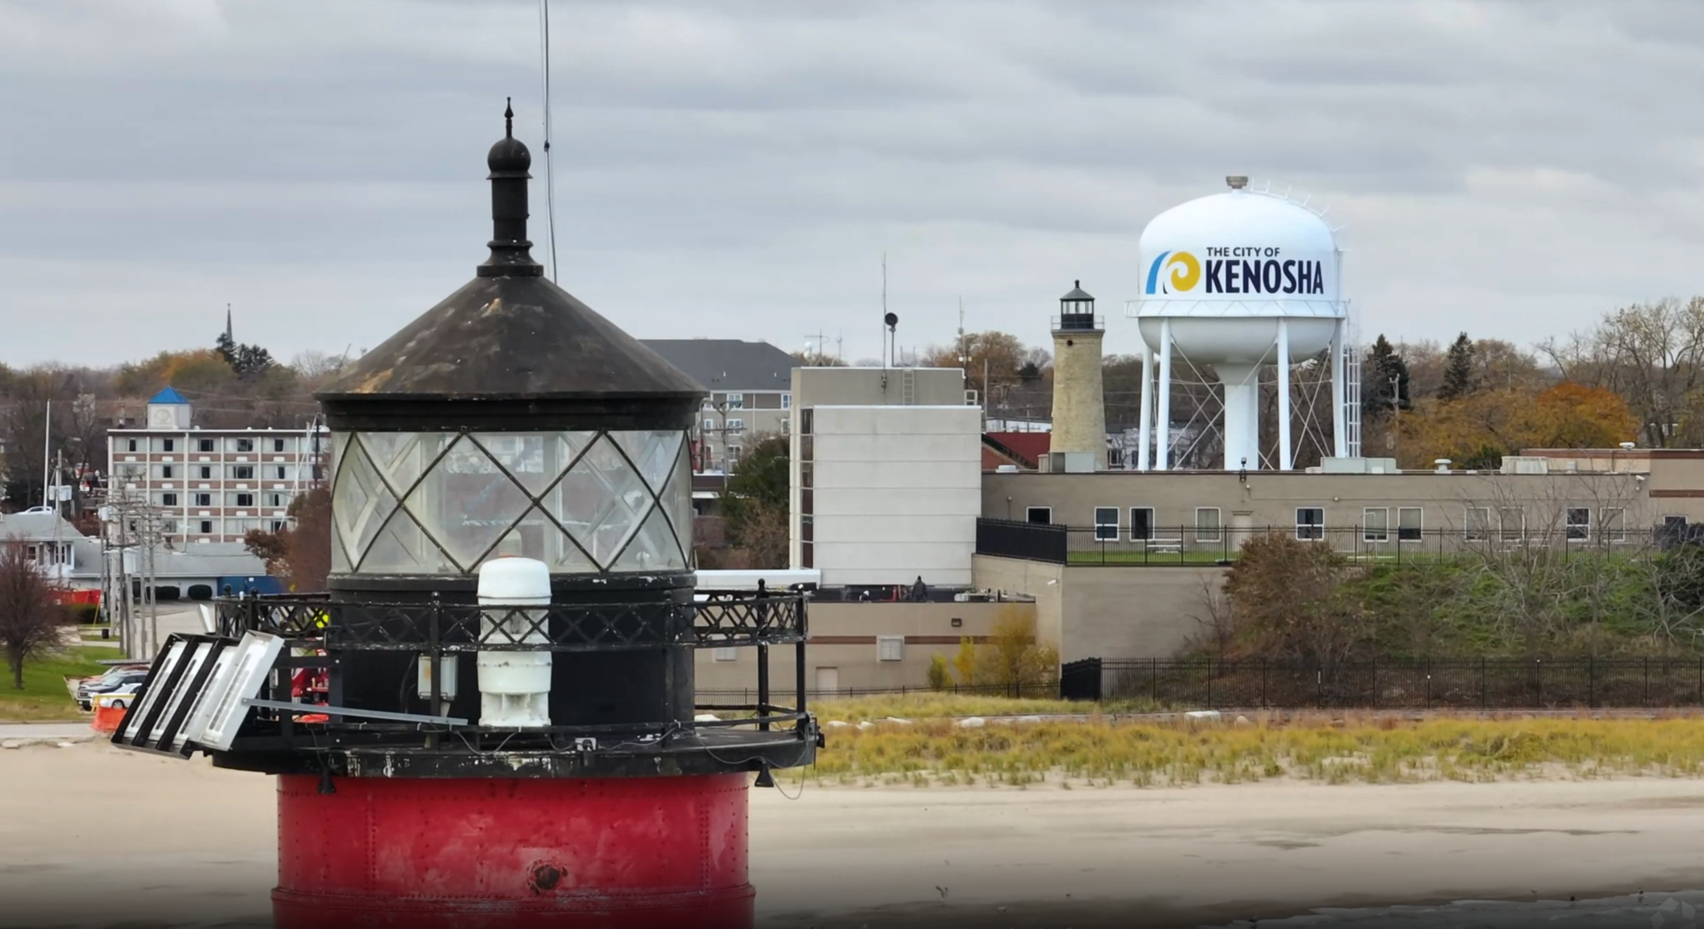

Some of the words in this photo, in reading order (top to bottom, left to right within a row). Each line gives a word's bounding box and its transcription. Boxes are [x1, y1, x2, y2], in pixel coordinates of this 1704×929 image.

[1206, 247, 1230, 257] THE
[1233, 247, 1261, 257] CITY
[1264, 247, 1280, 257] OF
[1205, 259, 1324, 294] KENOSHA
